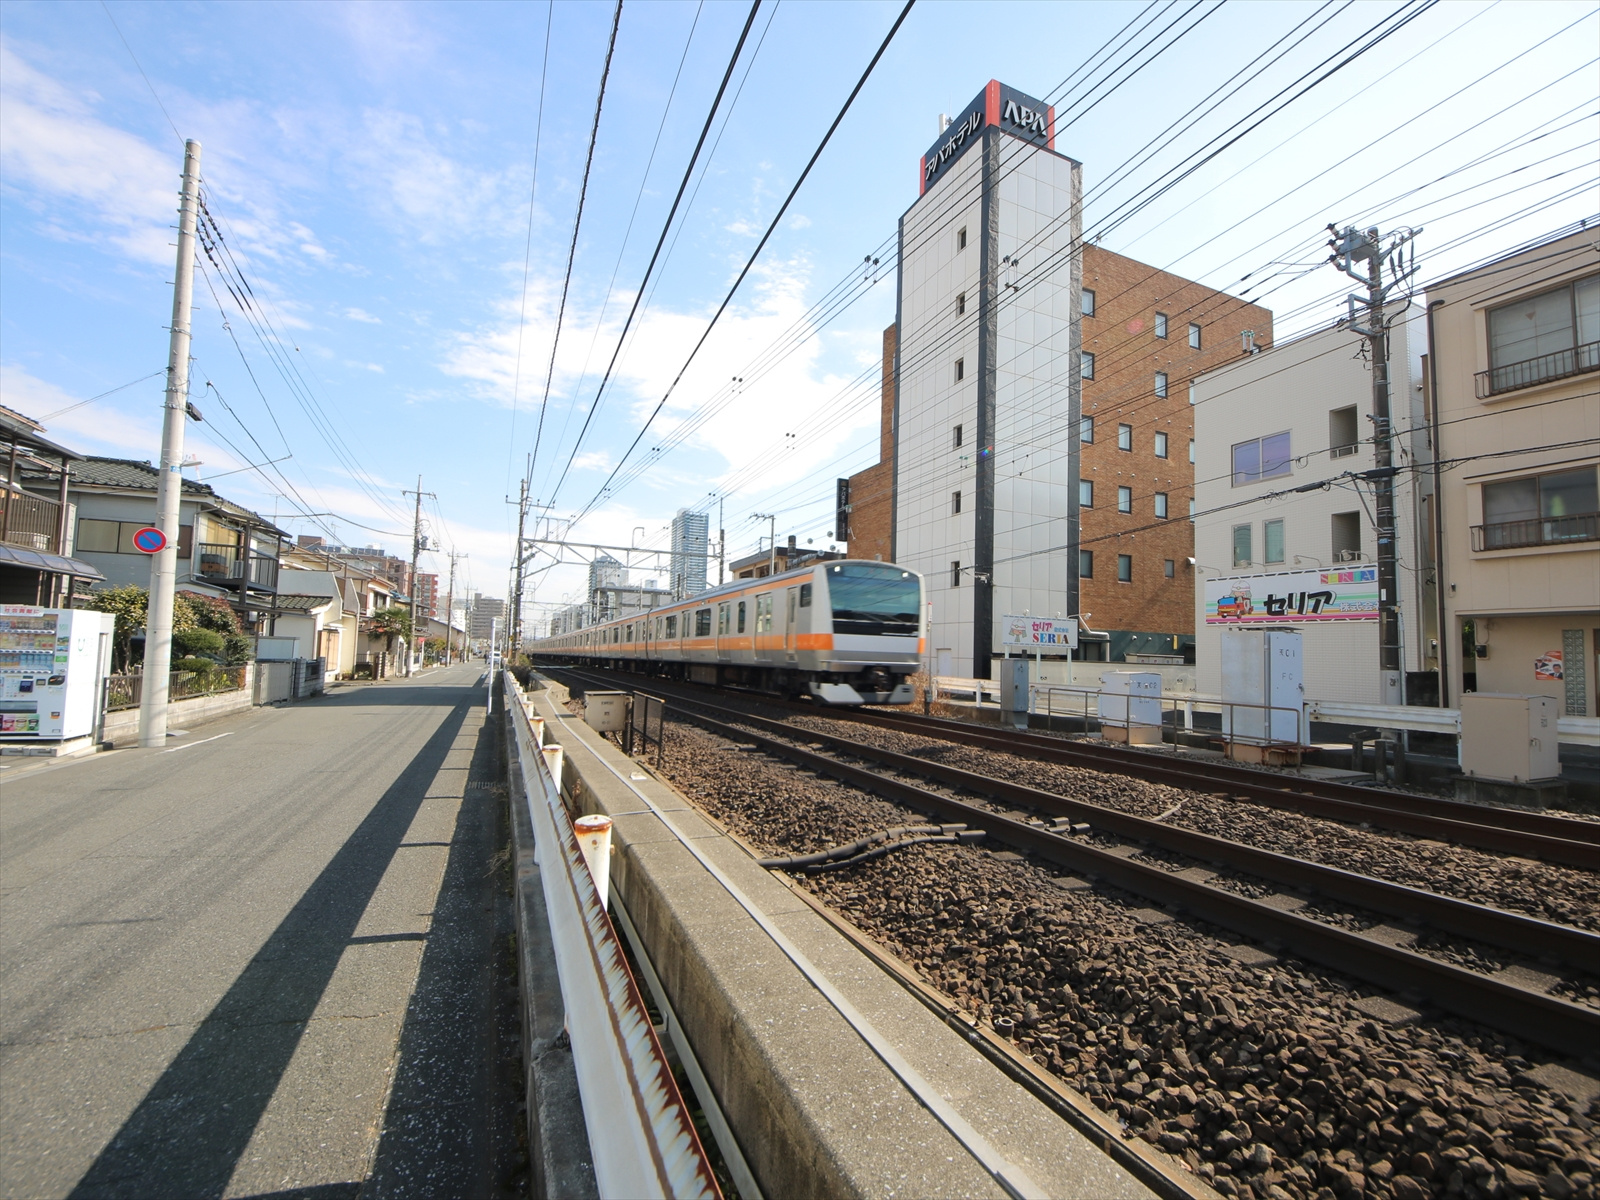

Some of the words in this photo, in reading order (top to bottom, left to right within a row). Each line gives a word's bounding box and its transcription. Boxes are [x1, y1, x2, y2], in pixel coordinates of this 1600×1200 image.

[925, 111, 981, 181] アパホテル
[1263, 590, 1337, 616] セリア
[1032, 621, 1052, 632] セリア
[1032, 633, 1069, 644] SERIA
